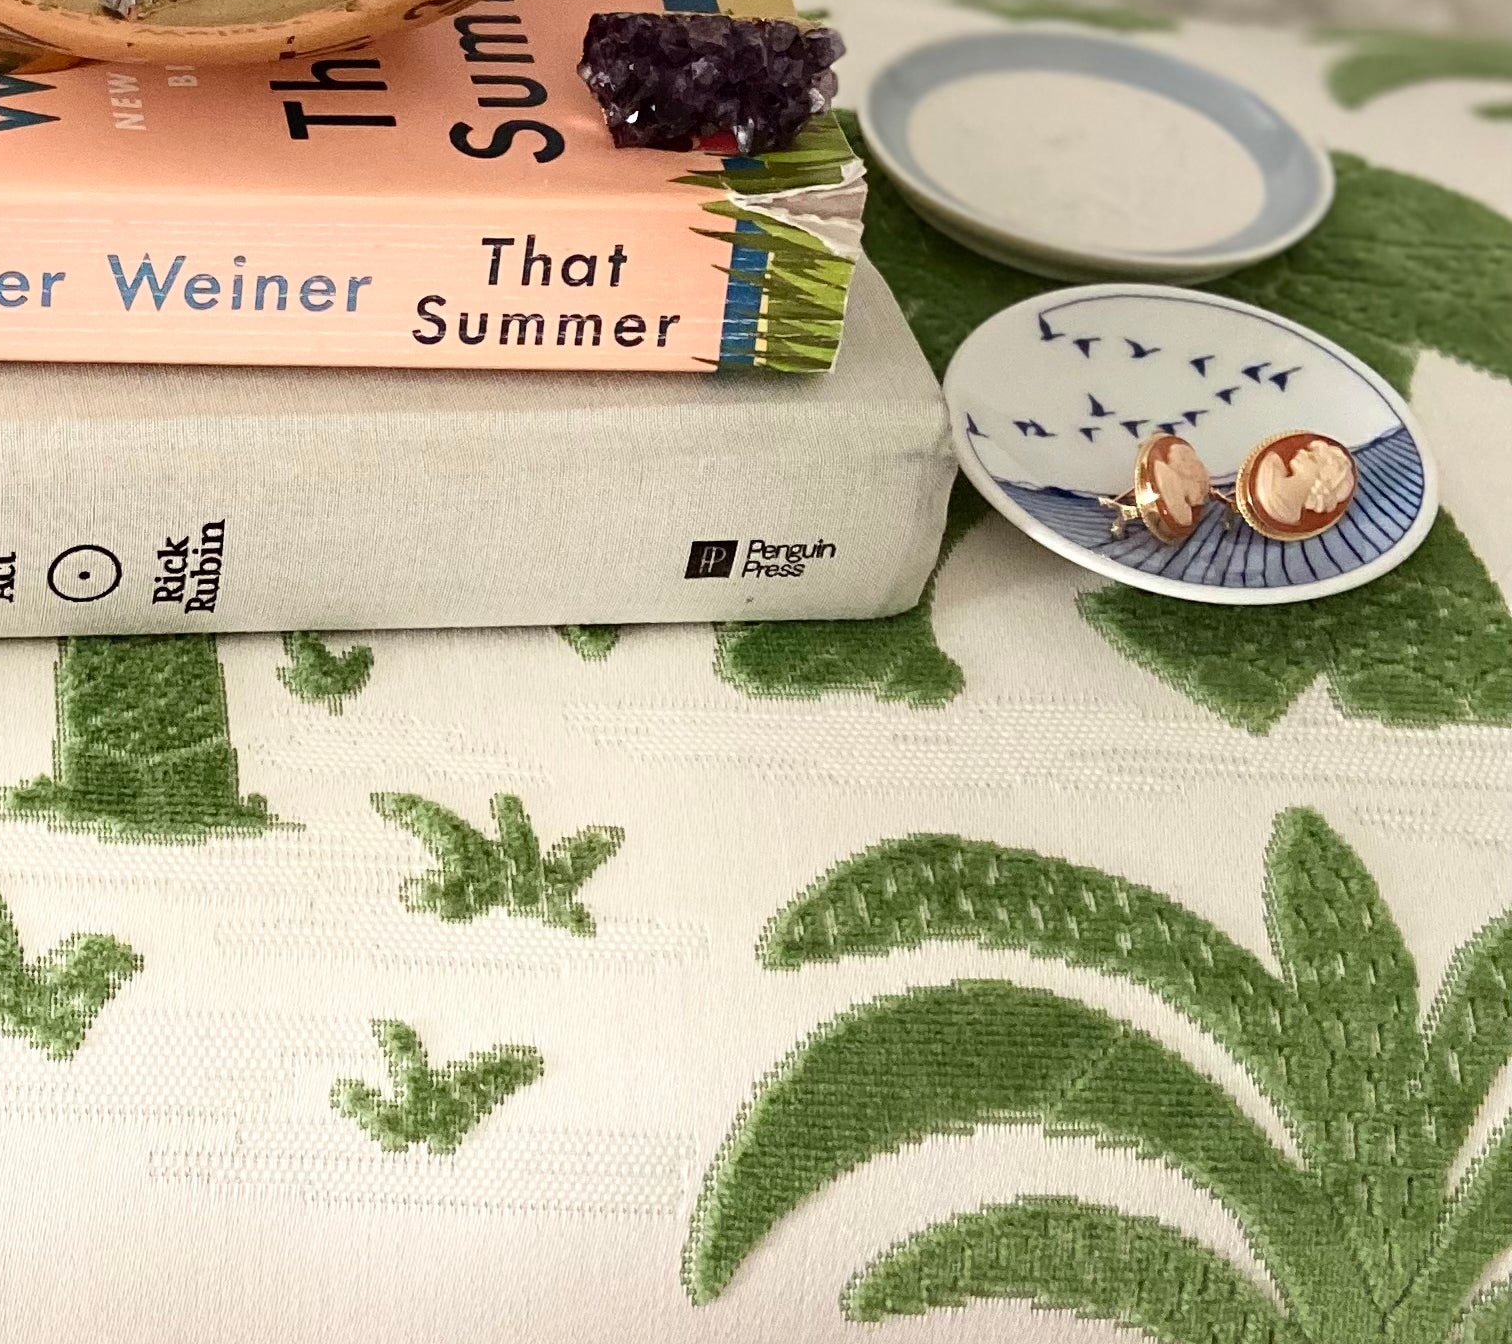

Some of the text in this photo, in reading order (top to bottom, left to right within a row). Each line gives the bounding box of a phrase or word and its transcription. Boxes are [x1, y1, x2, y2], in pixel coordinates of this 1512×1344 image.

[106, 70, 148, 132] NEW
[268, 58, 397, 141] Th
[106, 252, 373, 313] Weiner
[481, 233, 628, 288] That
[411, 294, 681, 348] Summer
[152, 535, 190, 605] Rick
[184, 518, 226, 614] Rubin
[741, 560, 806, 579] Press
[747, 538, 837, 563] Penguin
